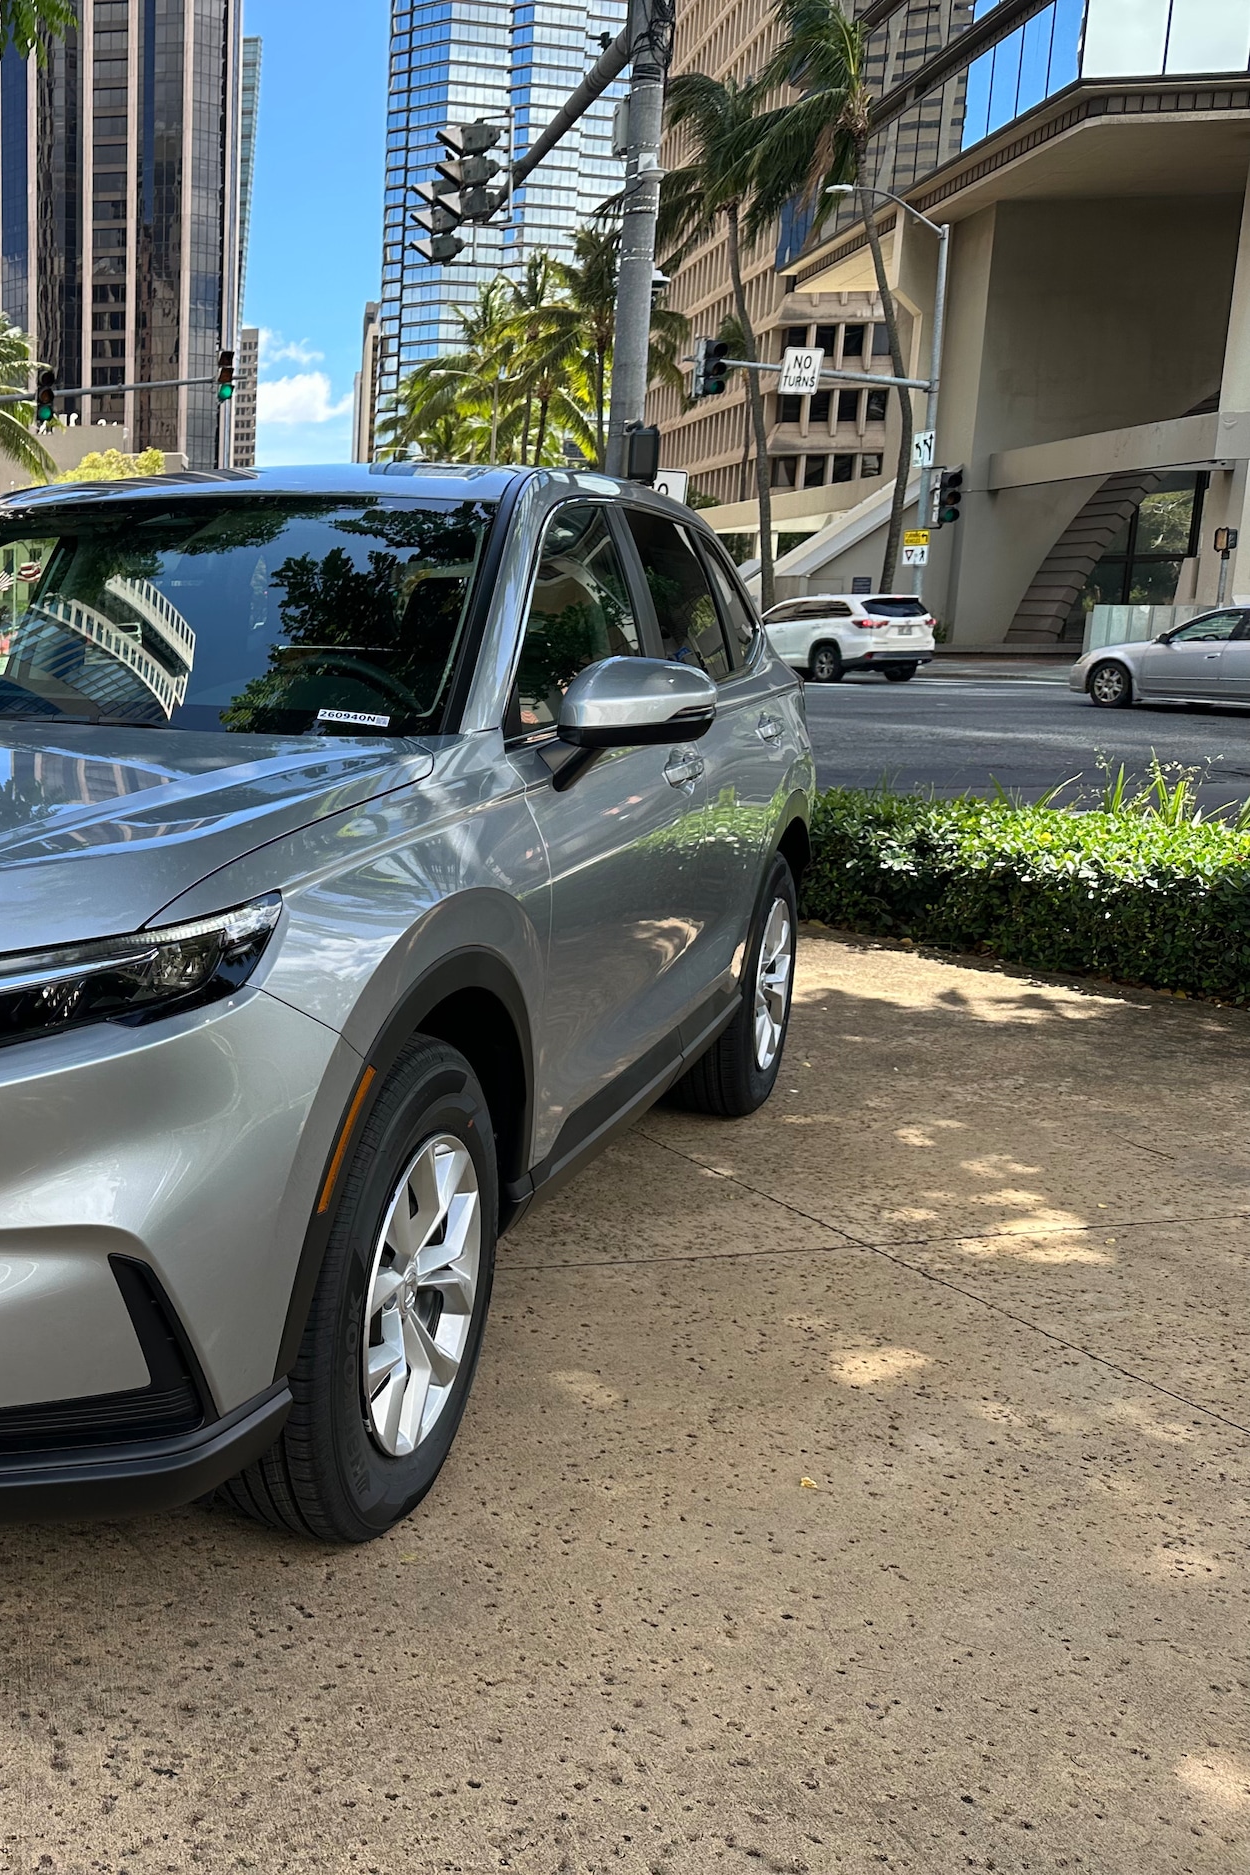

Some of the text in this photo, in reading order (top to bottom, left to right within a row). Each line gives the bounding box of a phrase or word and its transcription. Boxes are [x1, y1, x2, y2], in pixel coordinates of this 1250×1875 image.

[793, 355, 812, 369] NO
[783, 375, 816, 387] TURNS
[319, 711, 376, 722] 260940N
